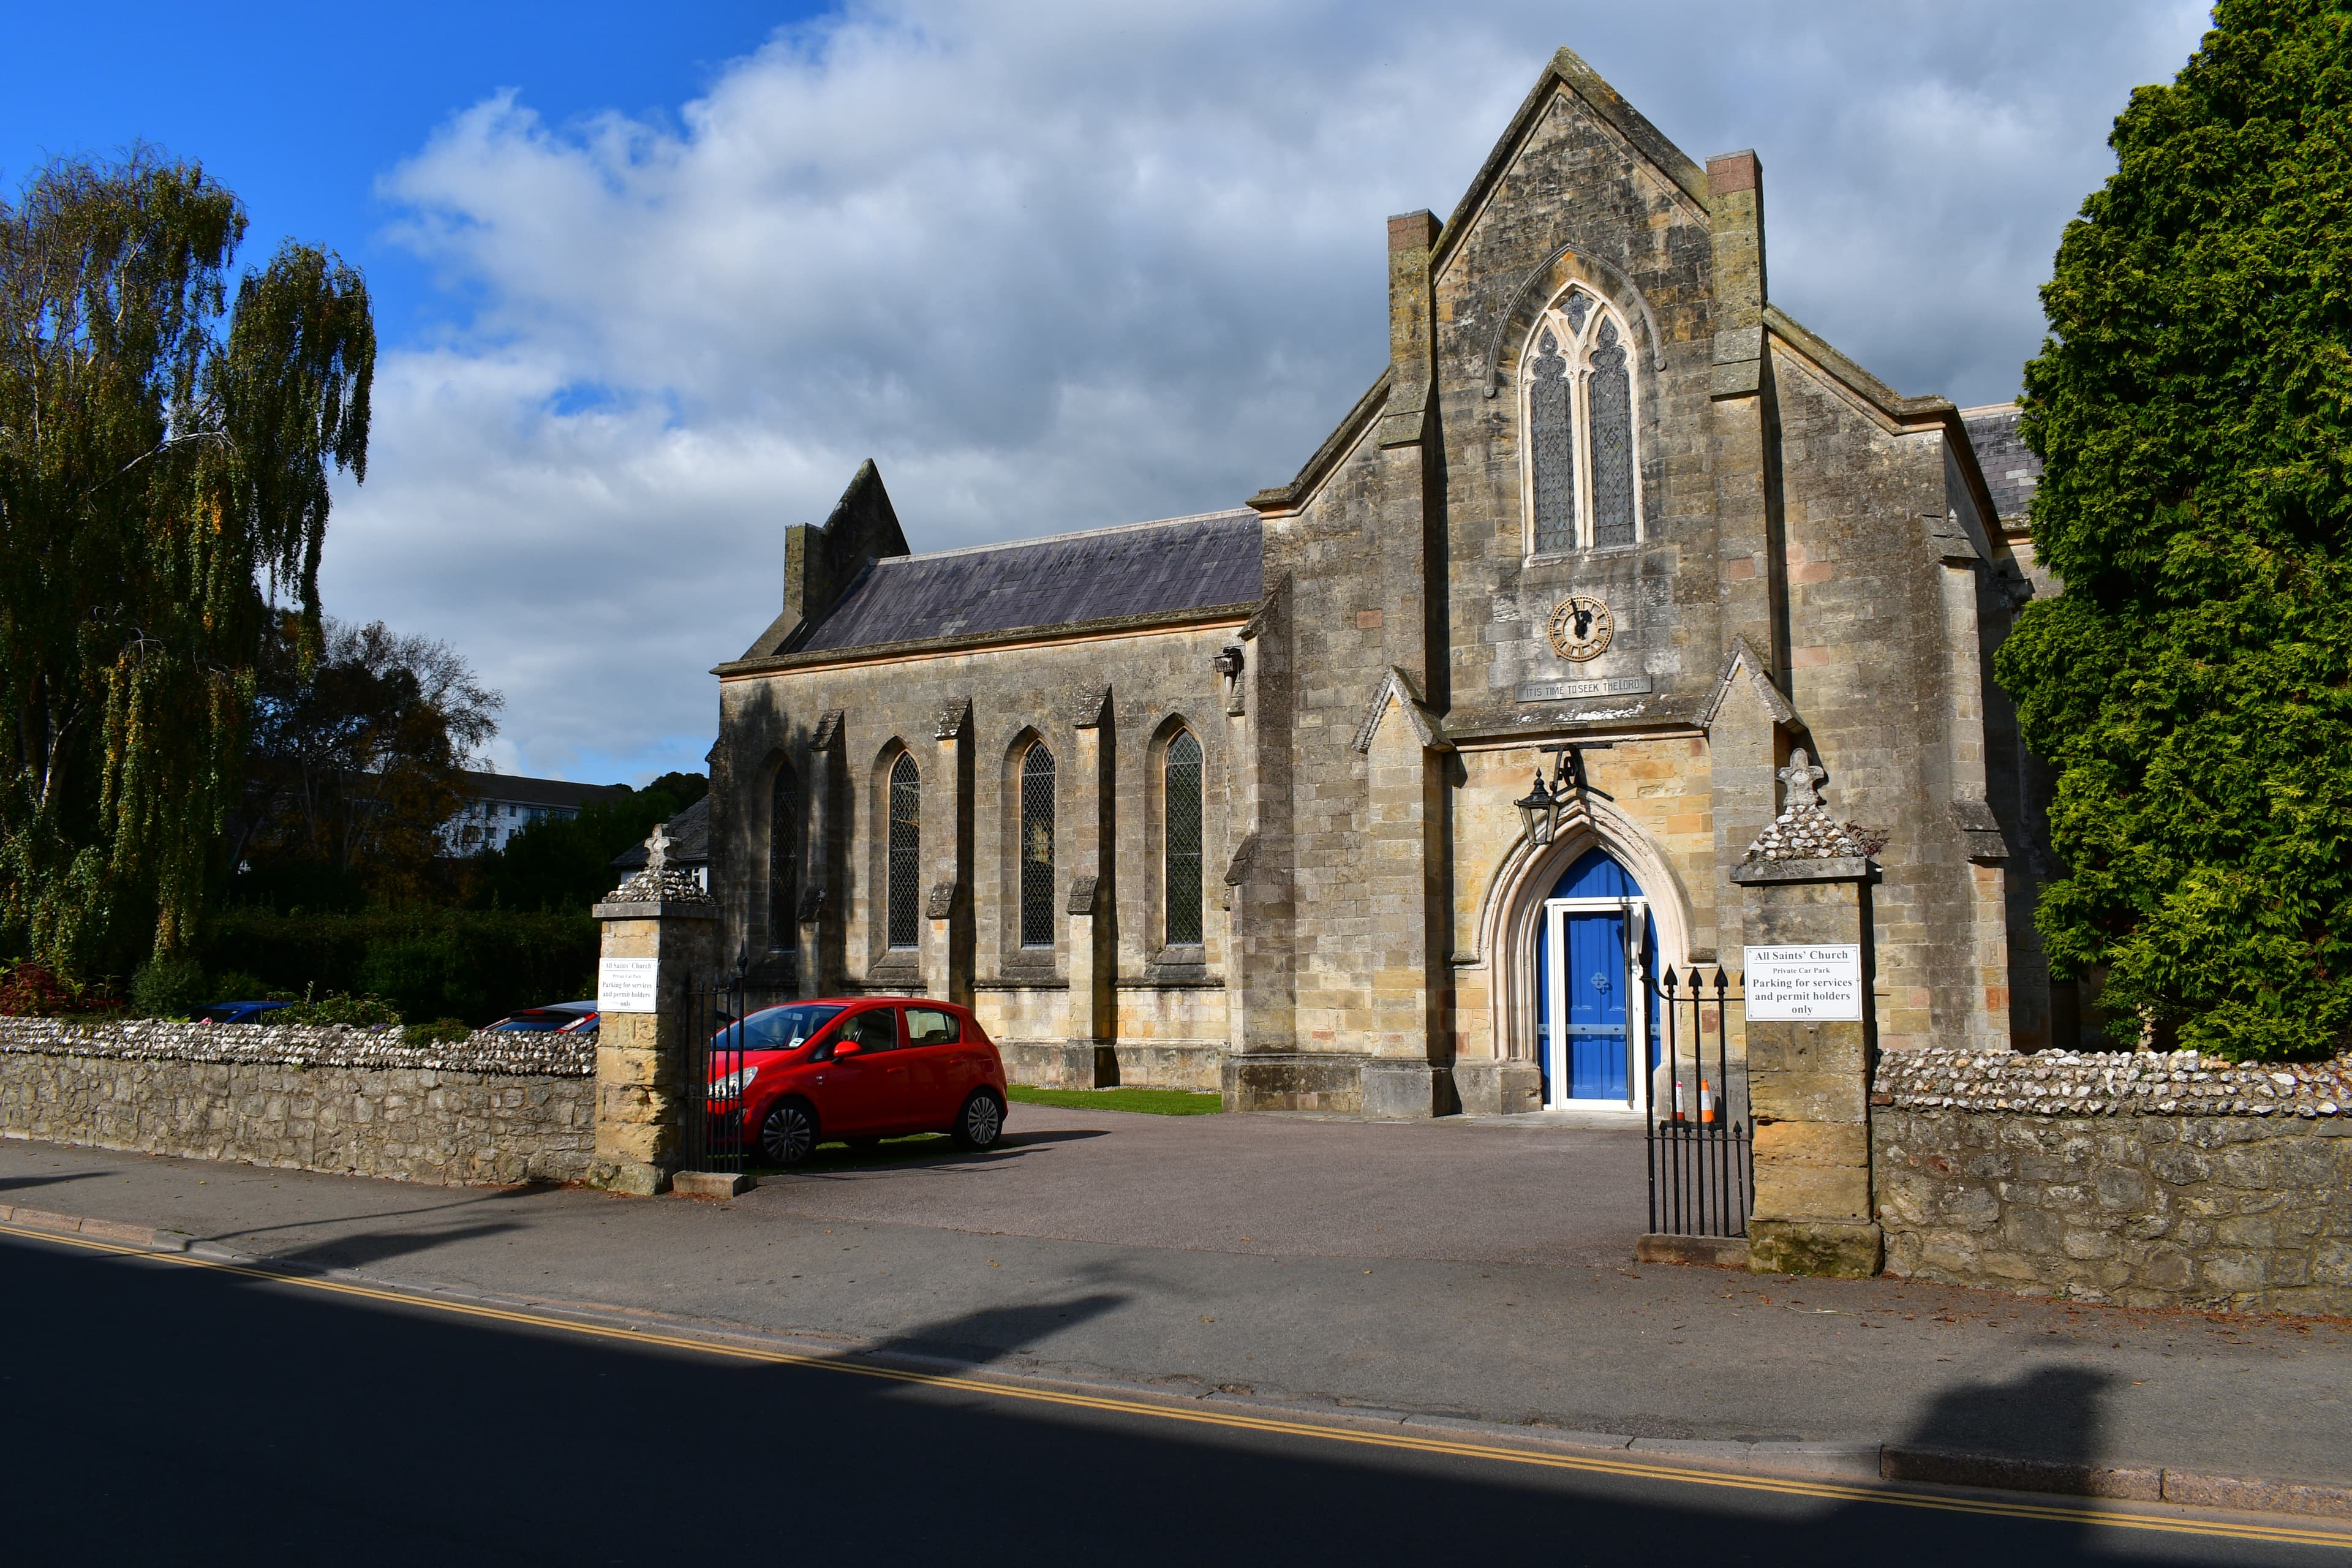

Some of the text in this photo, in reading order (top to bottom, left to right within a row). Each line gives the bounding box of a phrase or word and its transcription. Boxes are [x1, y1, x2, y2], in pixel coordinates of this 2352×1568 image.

[1534, 688, 1542, 696] IS
[1545, 687, 1564, 696] TIME
[1567, 685, 1577, 694] TO
[1578, 684, 1599, 693] SEEK
[1603, 682, 1618, 692] THE
[1773, 951, 1806, 960] Saints’
[1810, 951, 1848, 959] Church
[1753, 979, 1792, 989] Parking
[1777, 992, 1809, 1002] permit
[1814, 992, 1850, 1000] holders
[1792, 1006, 1812, 1016] only
